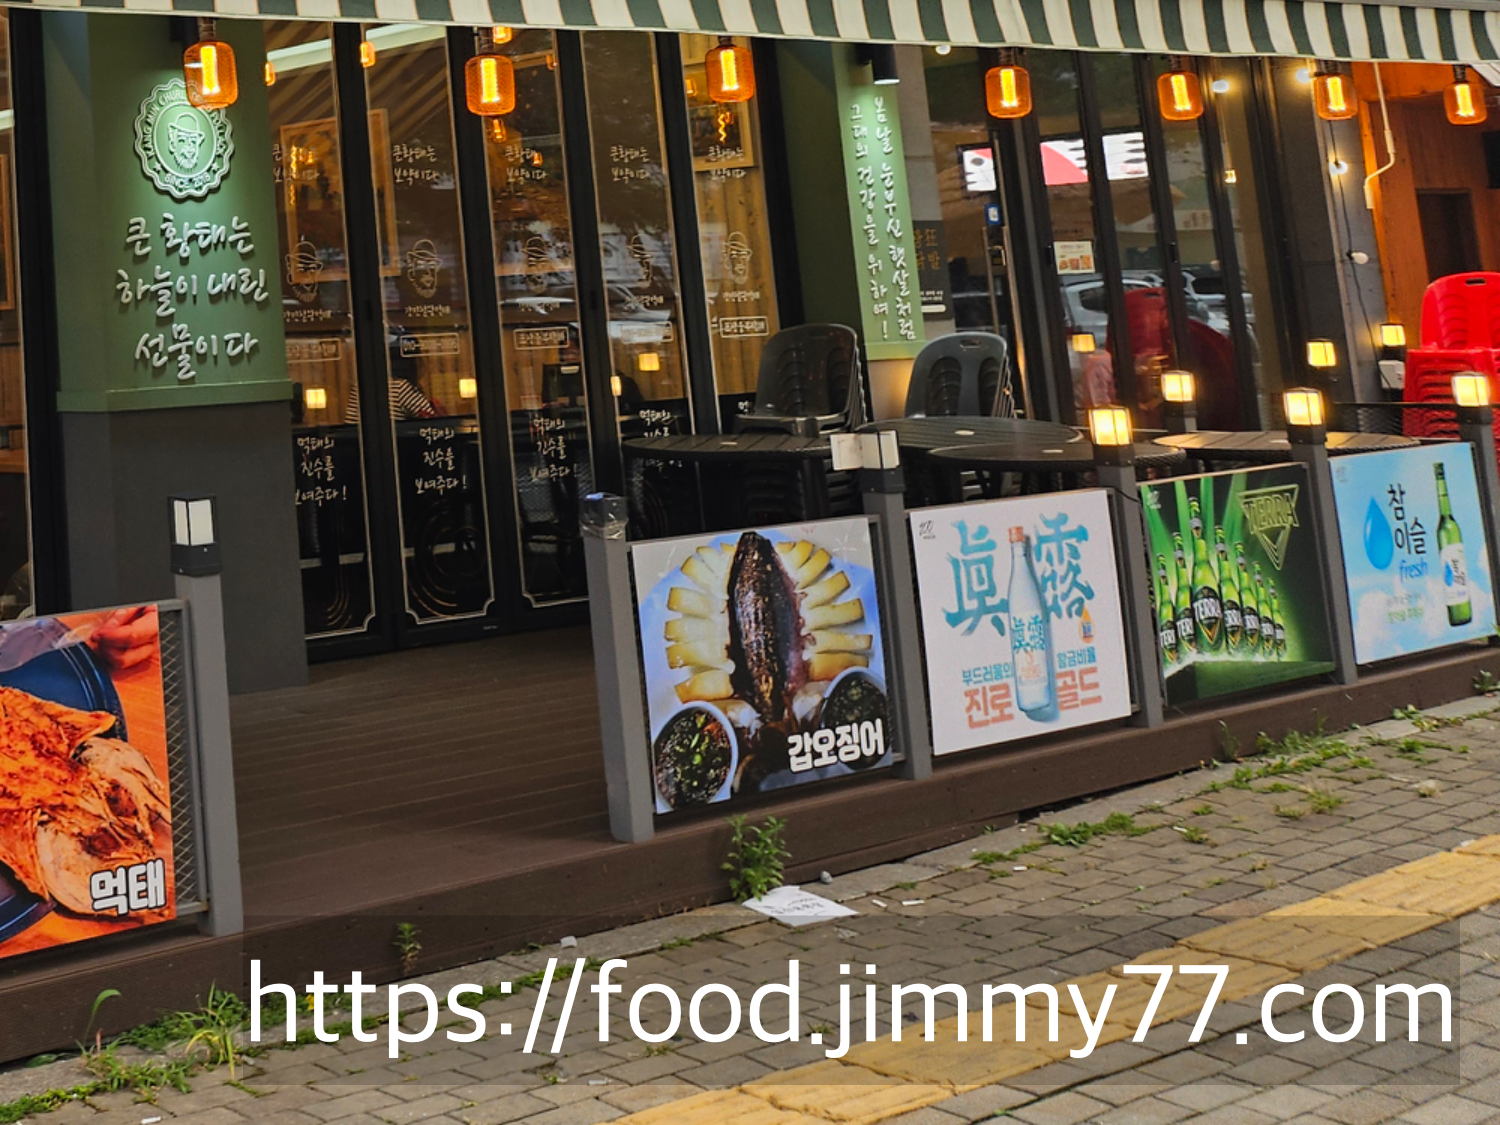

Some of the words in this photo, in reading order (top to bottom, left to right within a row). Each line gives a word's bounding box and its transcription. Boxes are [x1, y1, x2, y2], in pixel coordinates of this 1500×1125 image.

[126, 216, 152, 256] 큰
[160, 212, 254, 258] 황태는
[116, 265, 198, 317] 하늘이
[207, 267, 268, 302] 내린
[135, 323, 259, 380] 선물이다
[297, 436, 335, 452] 먹태의
[419, 427, 455, 445] 먹태의
[423, 447, 455, 471] 진수를
[301, 454, 335, 481] 진수를
[1243, 492, 1299, 535] TERRA
[964, 683, 1014, 729] 진로
[1055, 667, 1102, 711] 골드
[787, 718, 885, 774] 갑오징어
[92, 859, 165, 915] 먹태
